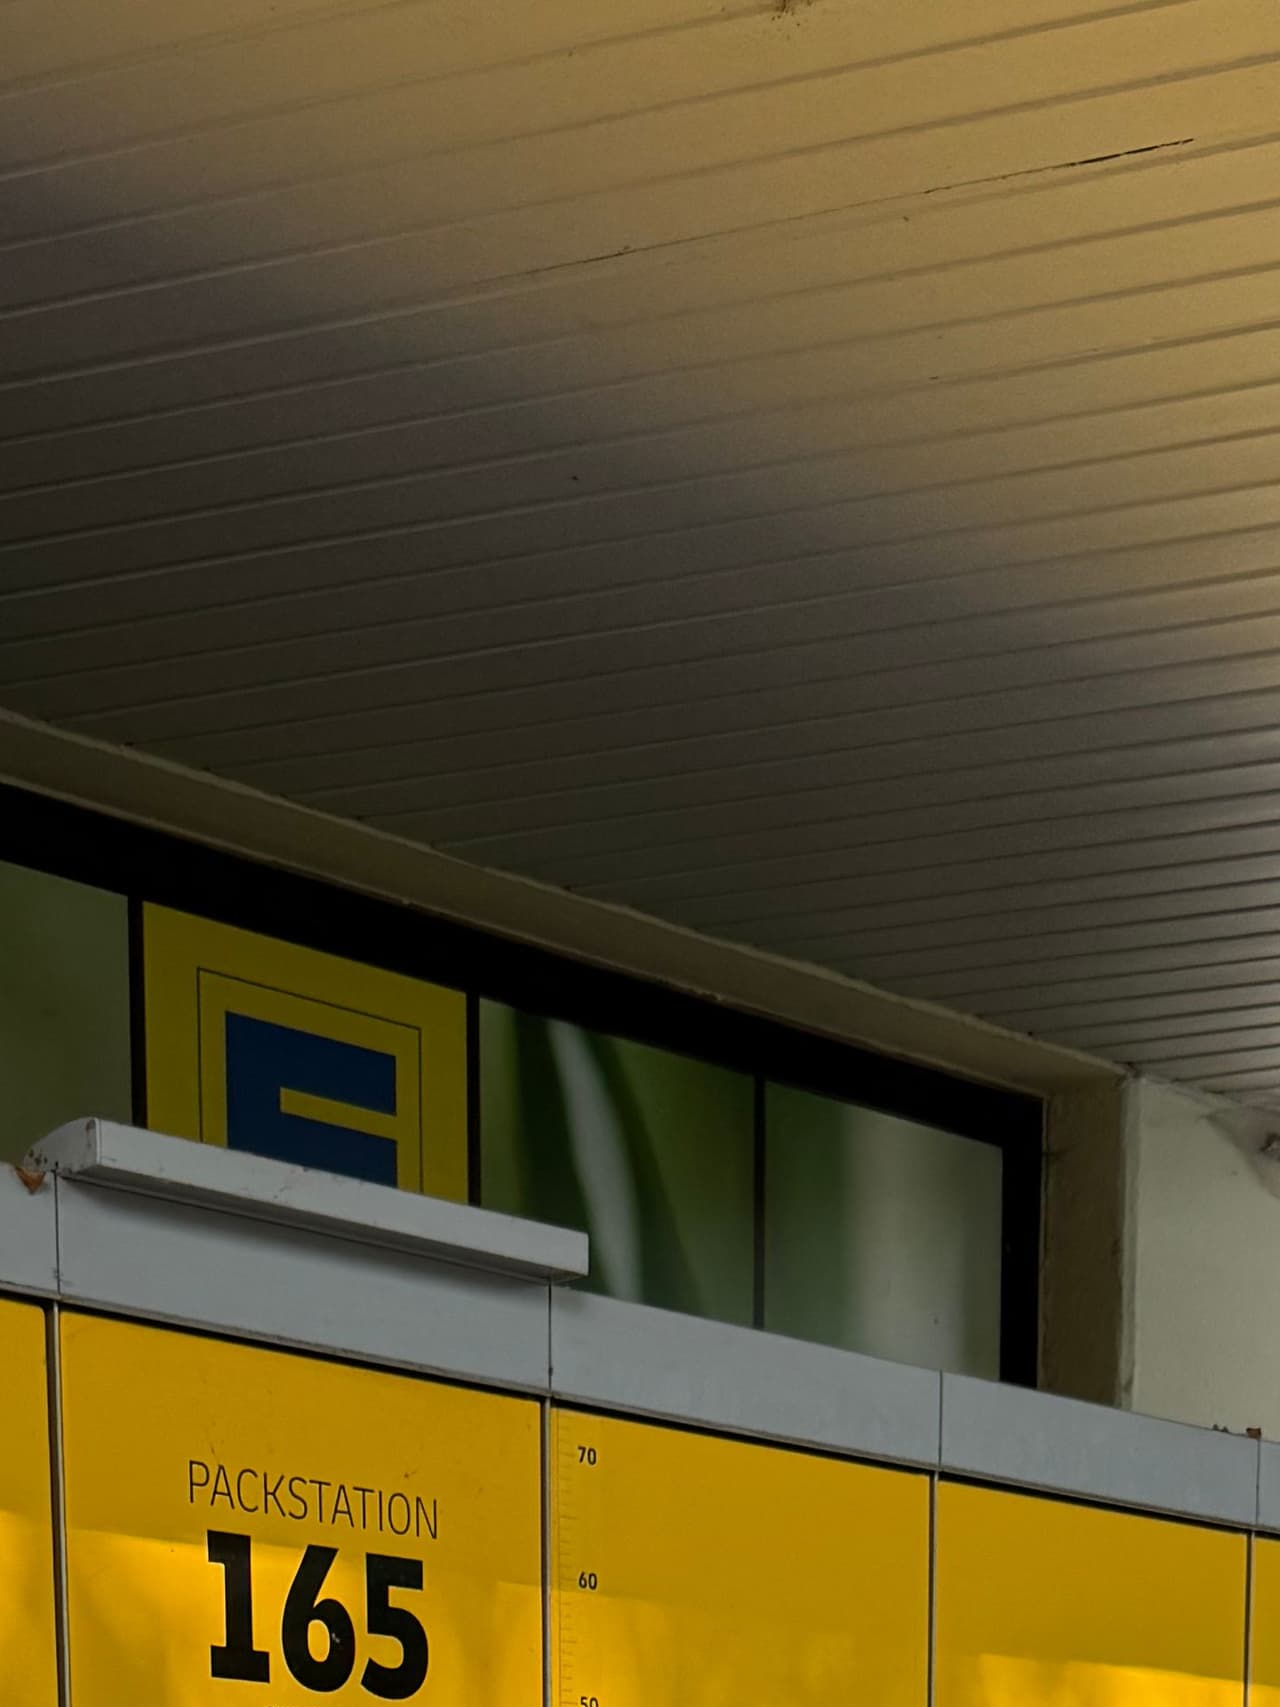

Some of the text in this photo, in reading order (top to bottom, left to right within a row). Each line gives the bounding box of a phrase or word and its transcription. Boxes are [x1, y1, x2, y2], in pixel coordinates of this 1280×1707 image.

[577, 1445, 597, 1466] 70
[189, 1459, 438, 1540] PACKSTATION
[578, 1572, 598, 1591] 60
[207, 1529, 429, 1701] 165
